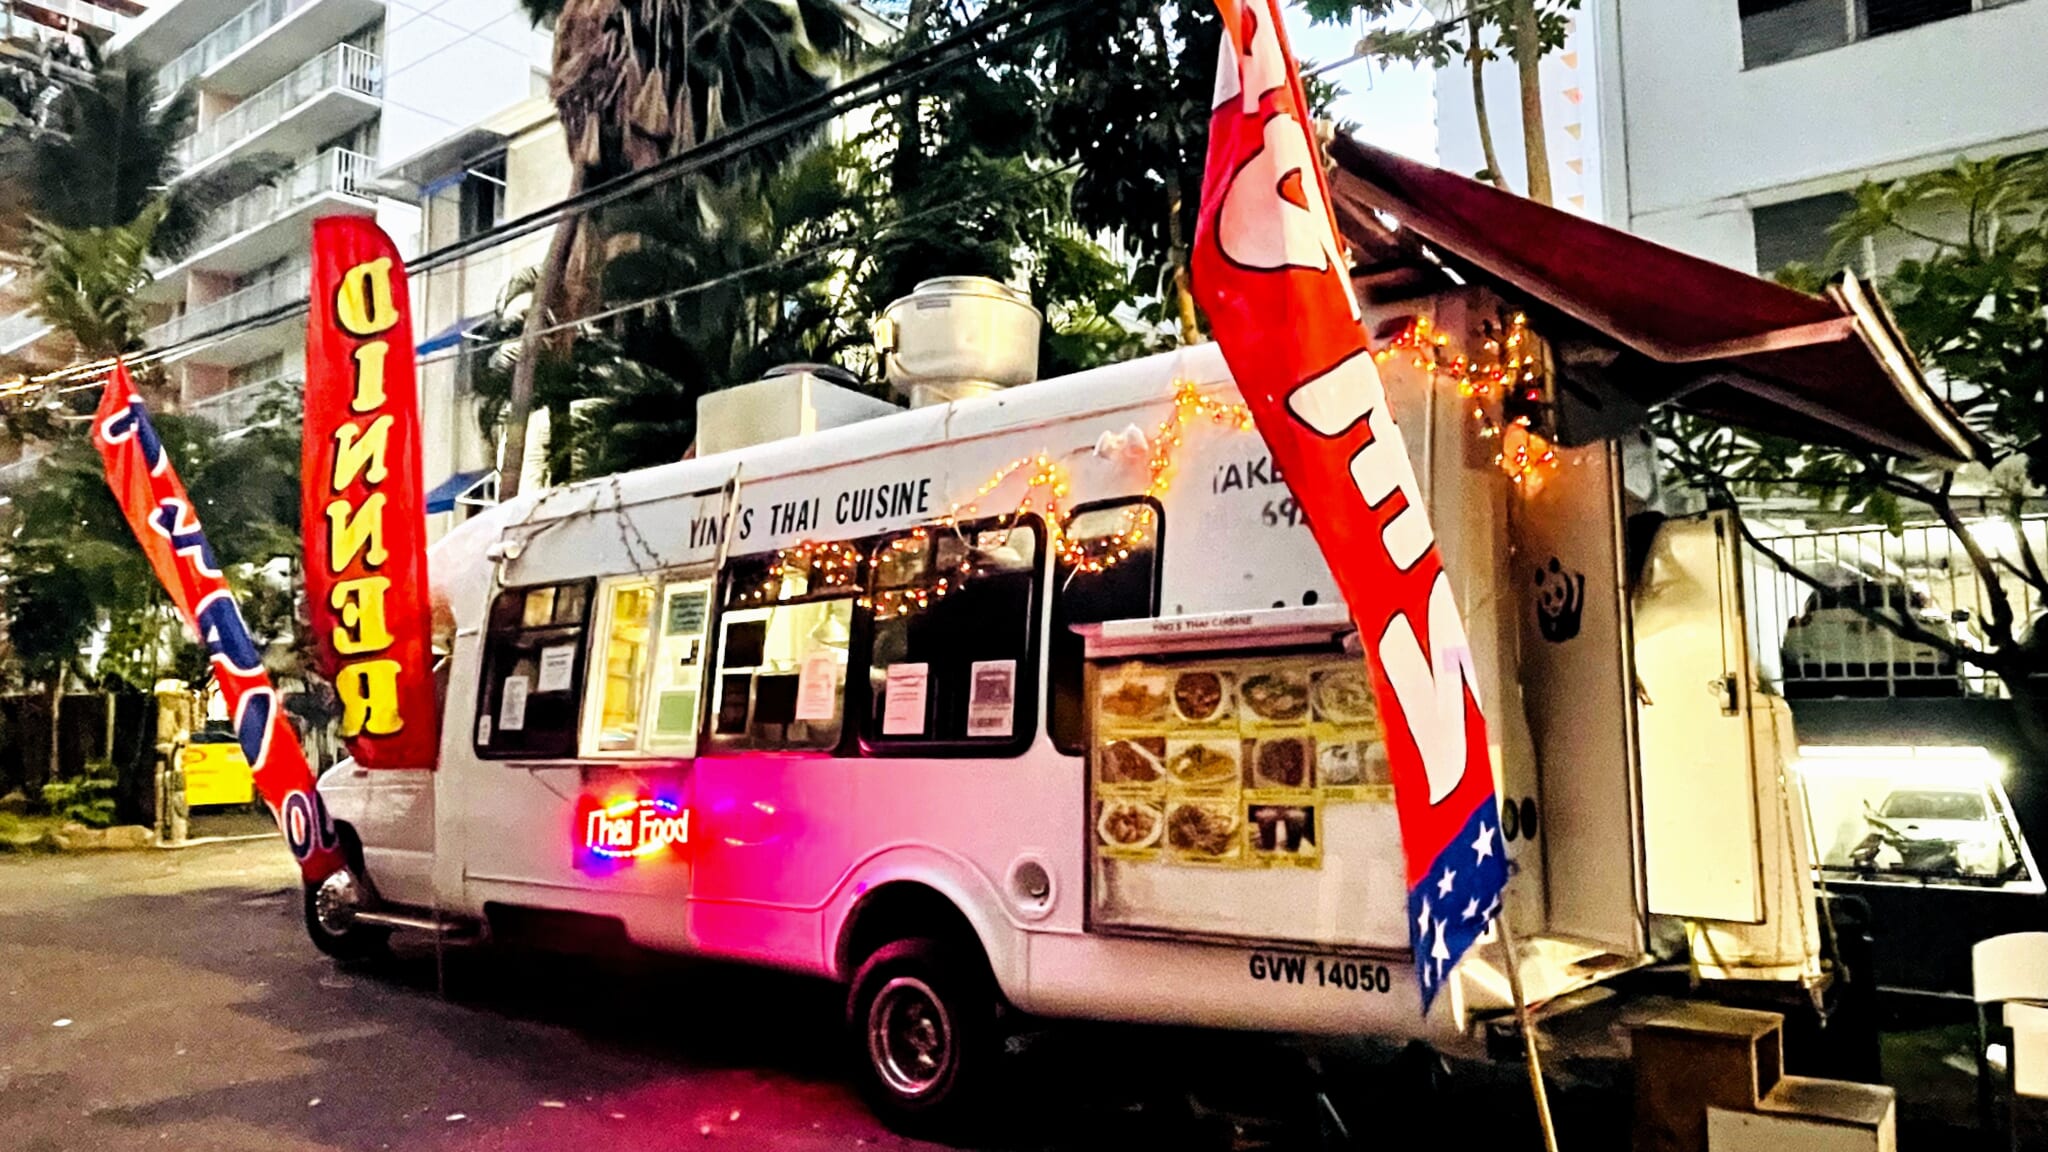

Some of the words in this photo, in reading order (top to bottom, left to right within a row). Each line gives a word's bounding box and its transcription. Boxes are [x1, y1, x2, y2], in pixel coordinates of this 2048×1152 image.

[770, 497, 820, 536] THAI
[835, 478, 932, 526] CUISINE
[586, 808, 634, 848] Thai
[637, 808, 690, 846] Food
[1249, 954, 1307, 985] GVW
[1314, 959, 1391, 994] 14050
